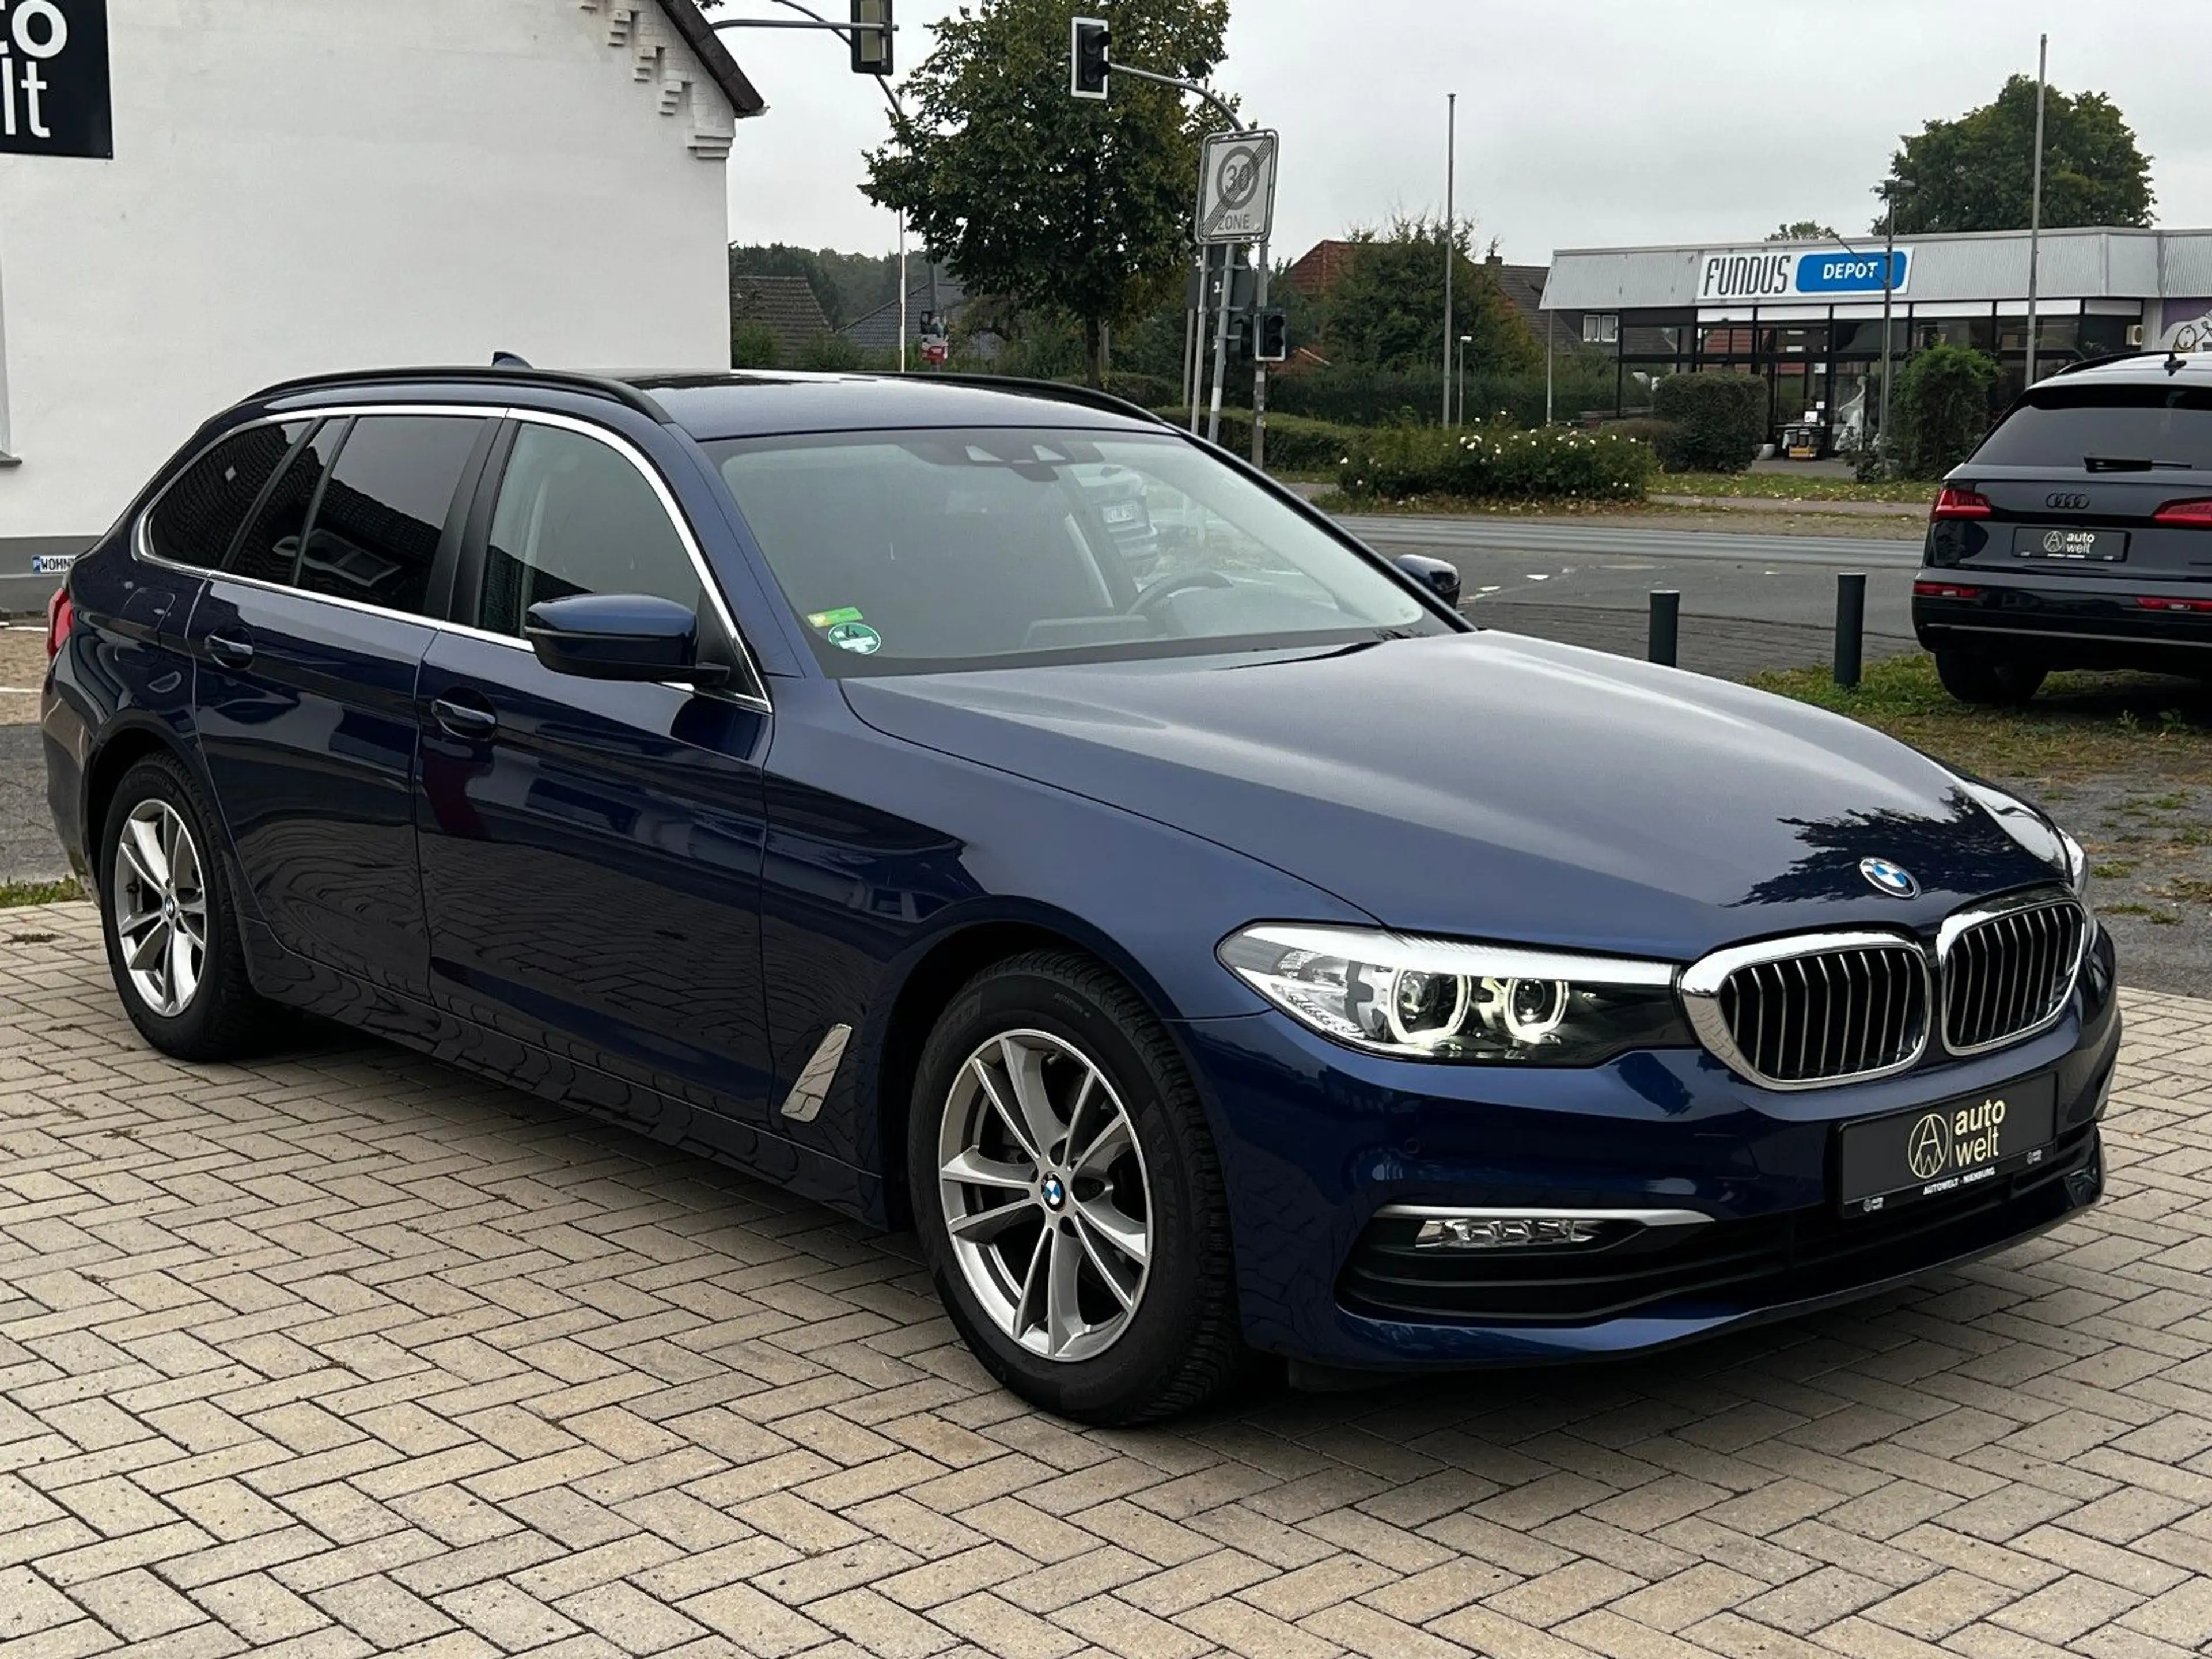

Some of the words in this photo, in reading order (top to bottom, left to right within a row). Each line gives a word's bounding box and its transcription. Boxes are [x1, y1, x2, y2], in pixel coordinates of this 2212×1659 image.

[1225, 163, 1251, 192] 30
[1217, 214, 1251, 230] ZONE
[1703, 255, 1791, 296] FUNDUS
[1823, 262, 1878, 280] DEPOT
[2066, 532, 2096, 543] auto
[1955, 1099, 2006, 1136] auto
[1955, 1127, 1999, 1168] welt
